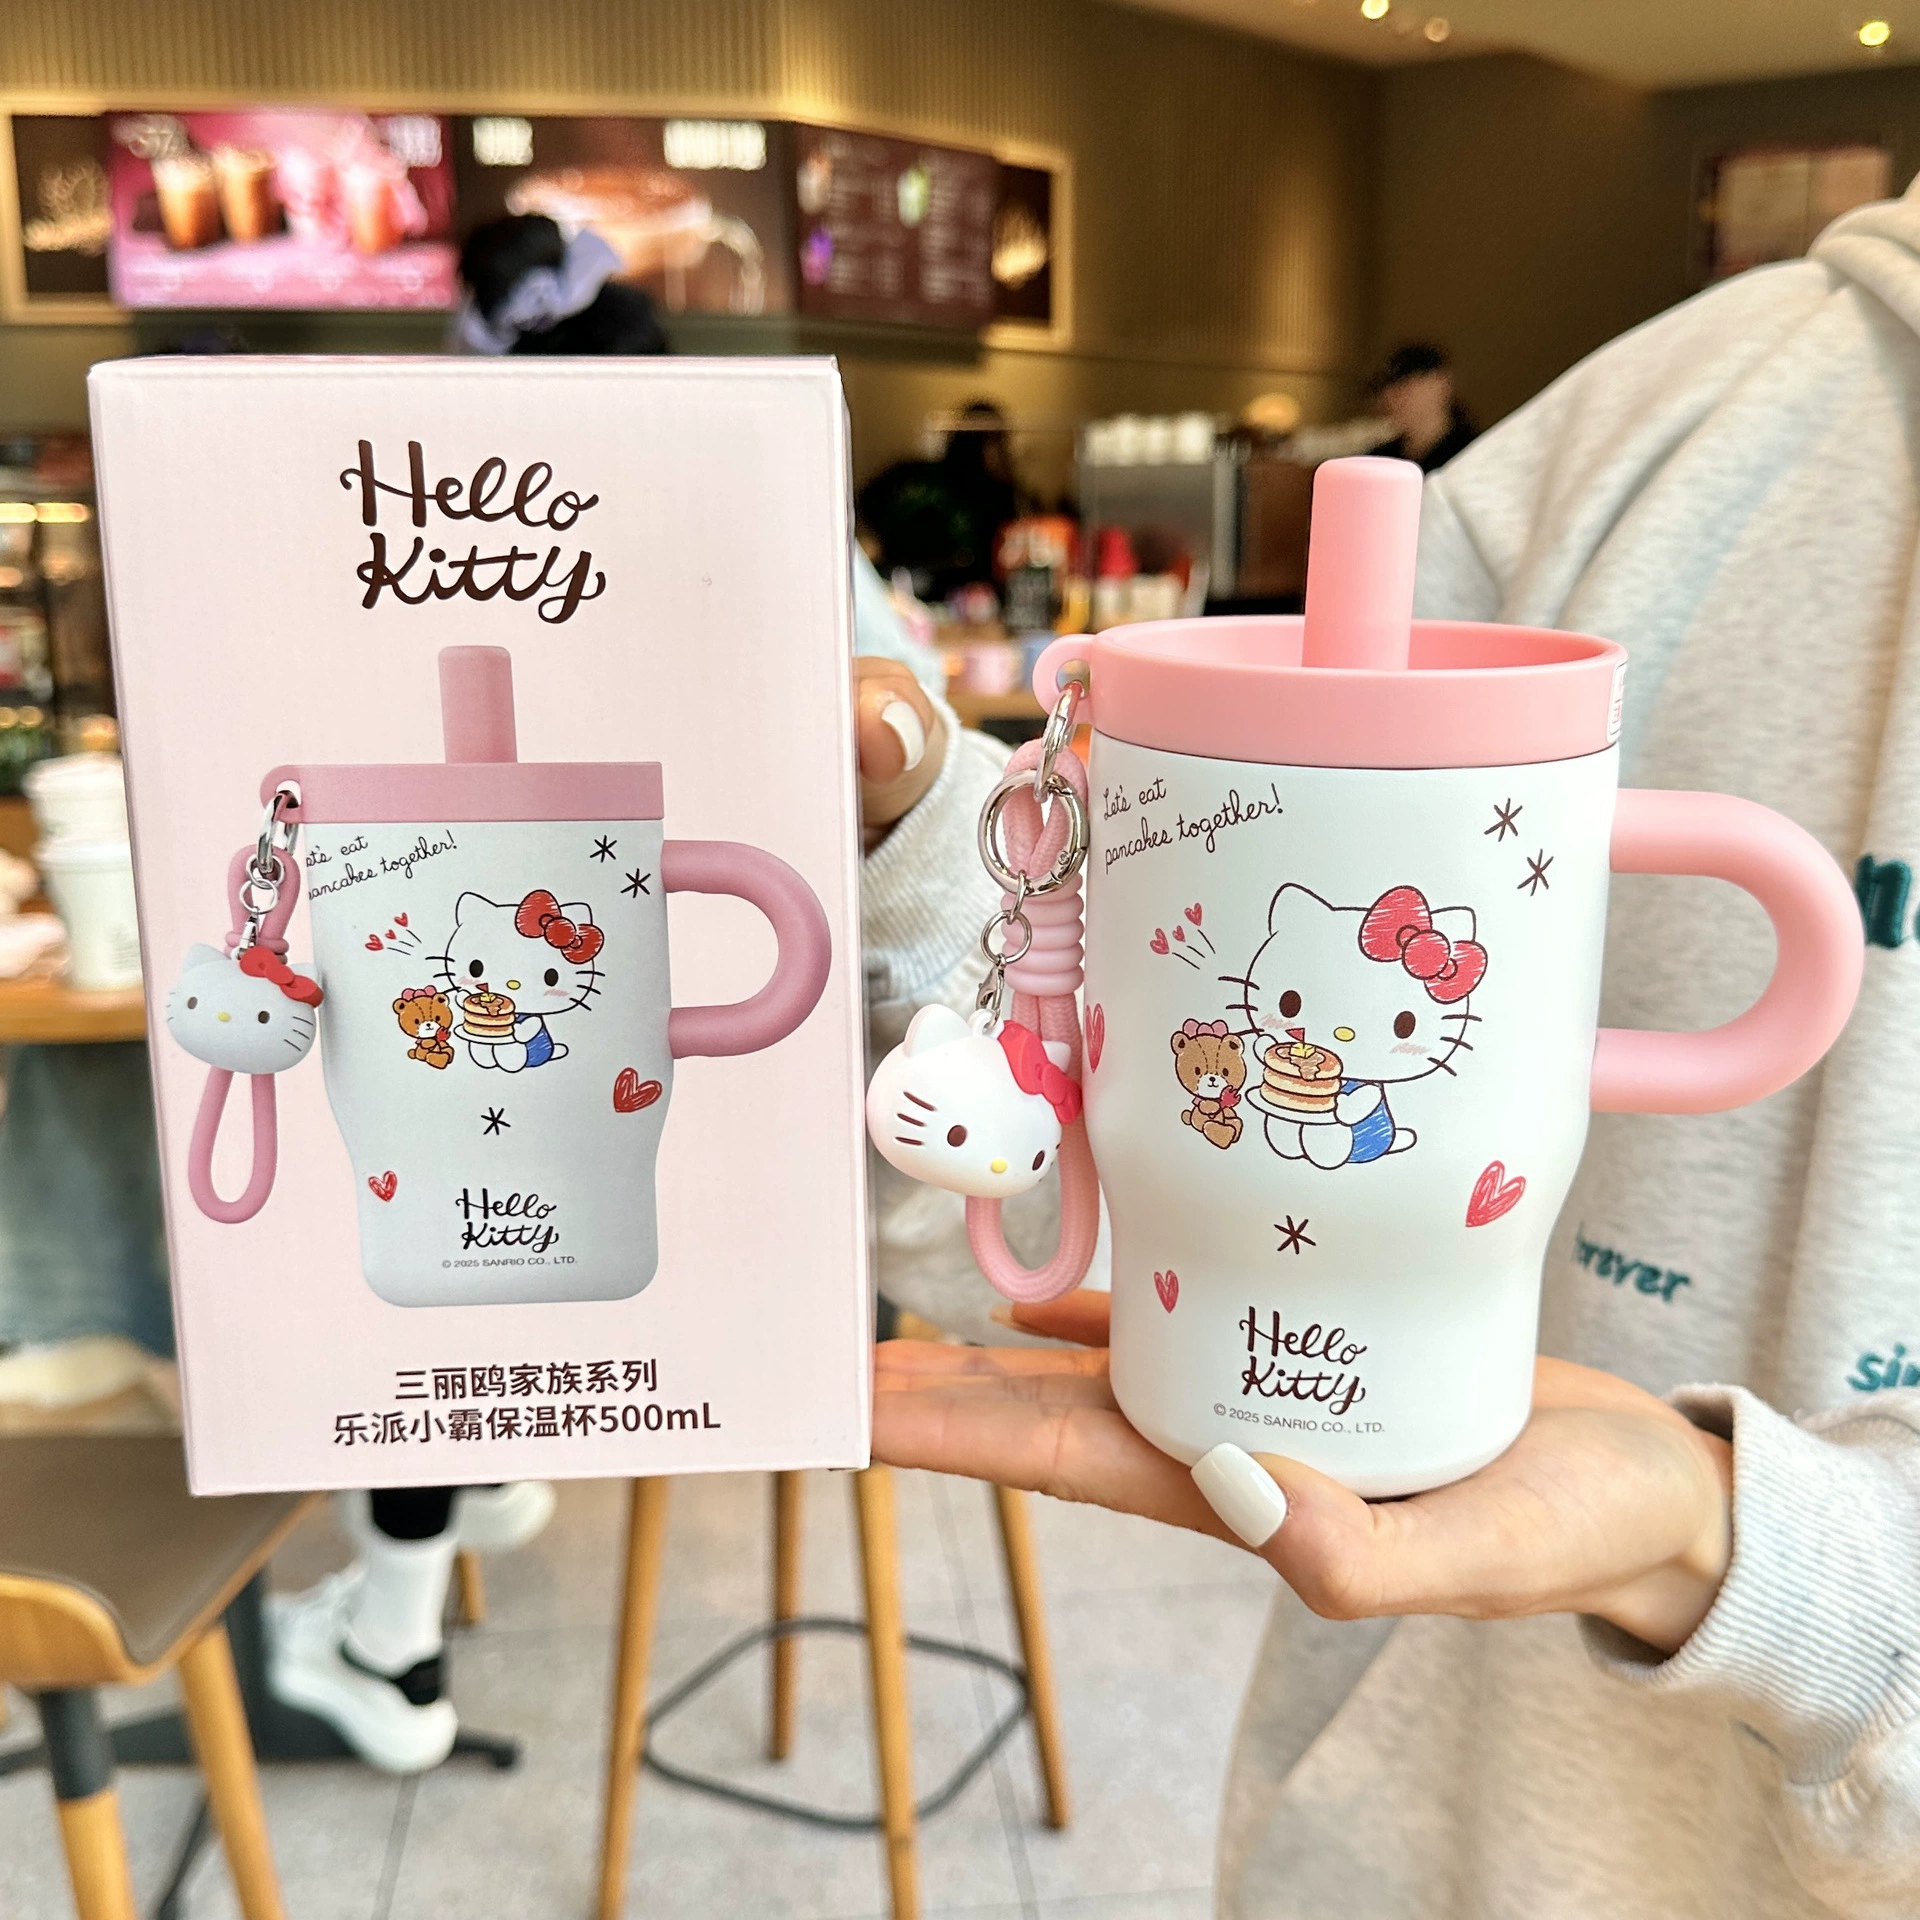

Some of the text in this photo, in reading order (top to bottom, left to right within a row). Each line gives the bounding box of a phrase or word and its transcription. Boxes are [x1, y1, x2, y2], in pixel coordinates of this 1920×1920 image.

[340, 439, 599, 531] Hello
[356, 532, 606, 624] Kitty
[1103, 777, 1167, 821] Let's eat
[306, 835, 368, 867] et's eat
[1105, 783, 1284, 875] pancakes together!
[380, 829, 457, 879] together!
[455, 1188, 557, 1219] Hello
[461, 1222, 559, 1253] Kitty
[454, 1259, 479, 1268] 2025
[482, 1257, 525, 1267] SANRIO
[553, 1255, 578, 1265] LTD.
[1239, 1306, 1367, 1365] Hello
[395, 1358, 658, 1401] 三丽鸥家族系列
[1241, 1355, 1366, 1415] Kitty
[334, 1402, 721, 1446] 乐派小霸保温杯500mL
[1229, 1408, 1260, 1423] 2025
[1263, 1415, 1317, 1431] SANRIO
[1321, 1422, 1352, 1434] CO.,
[1355, 1422, 1386, 1433] LTD.
